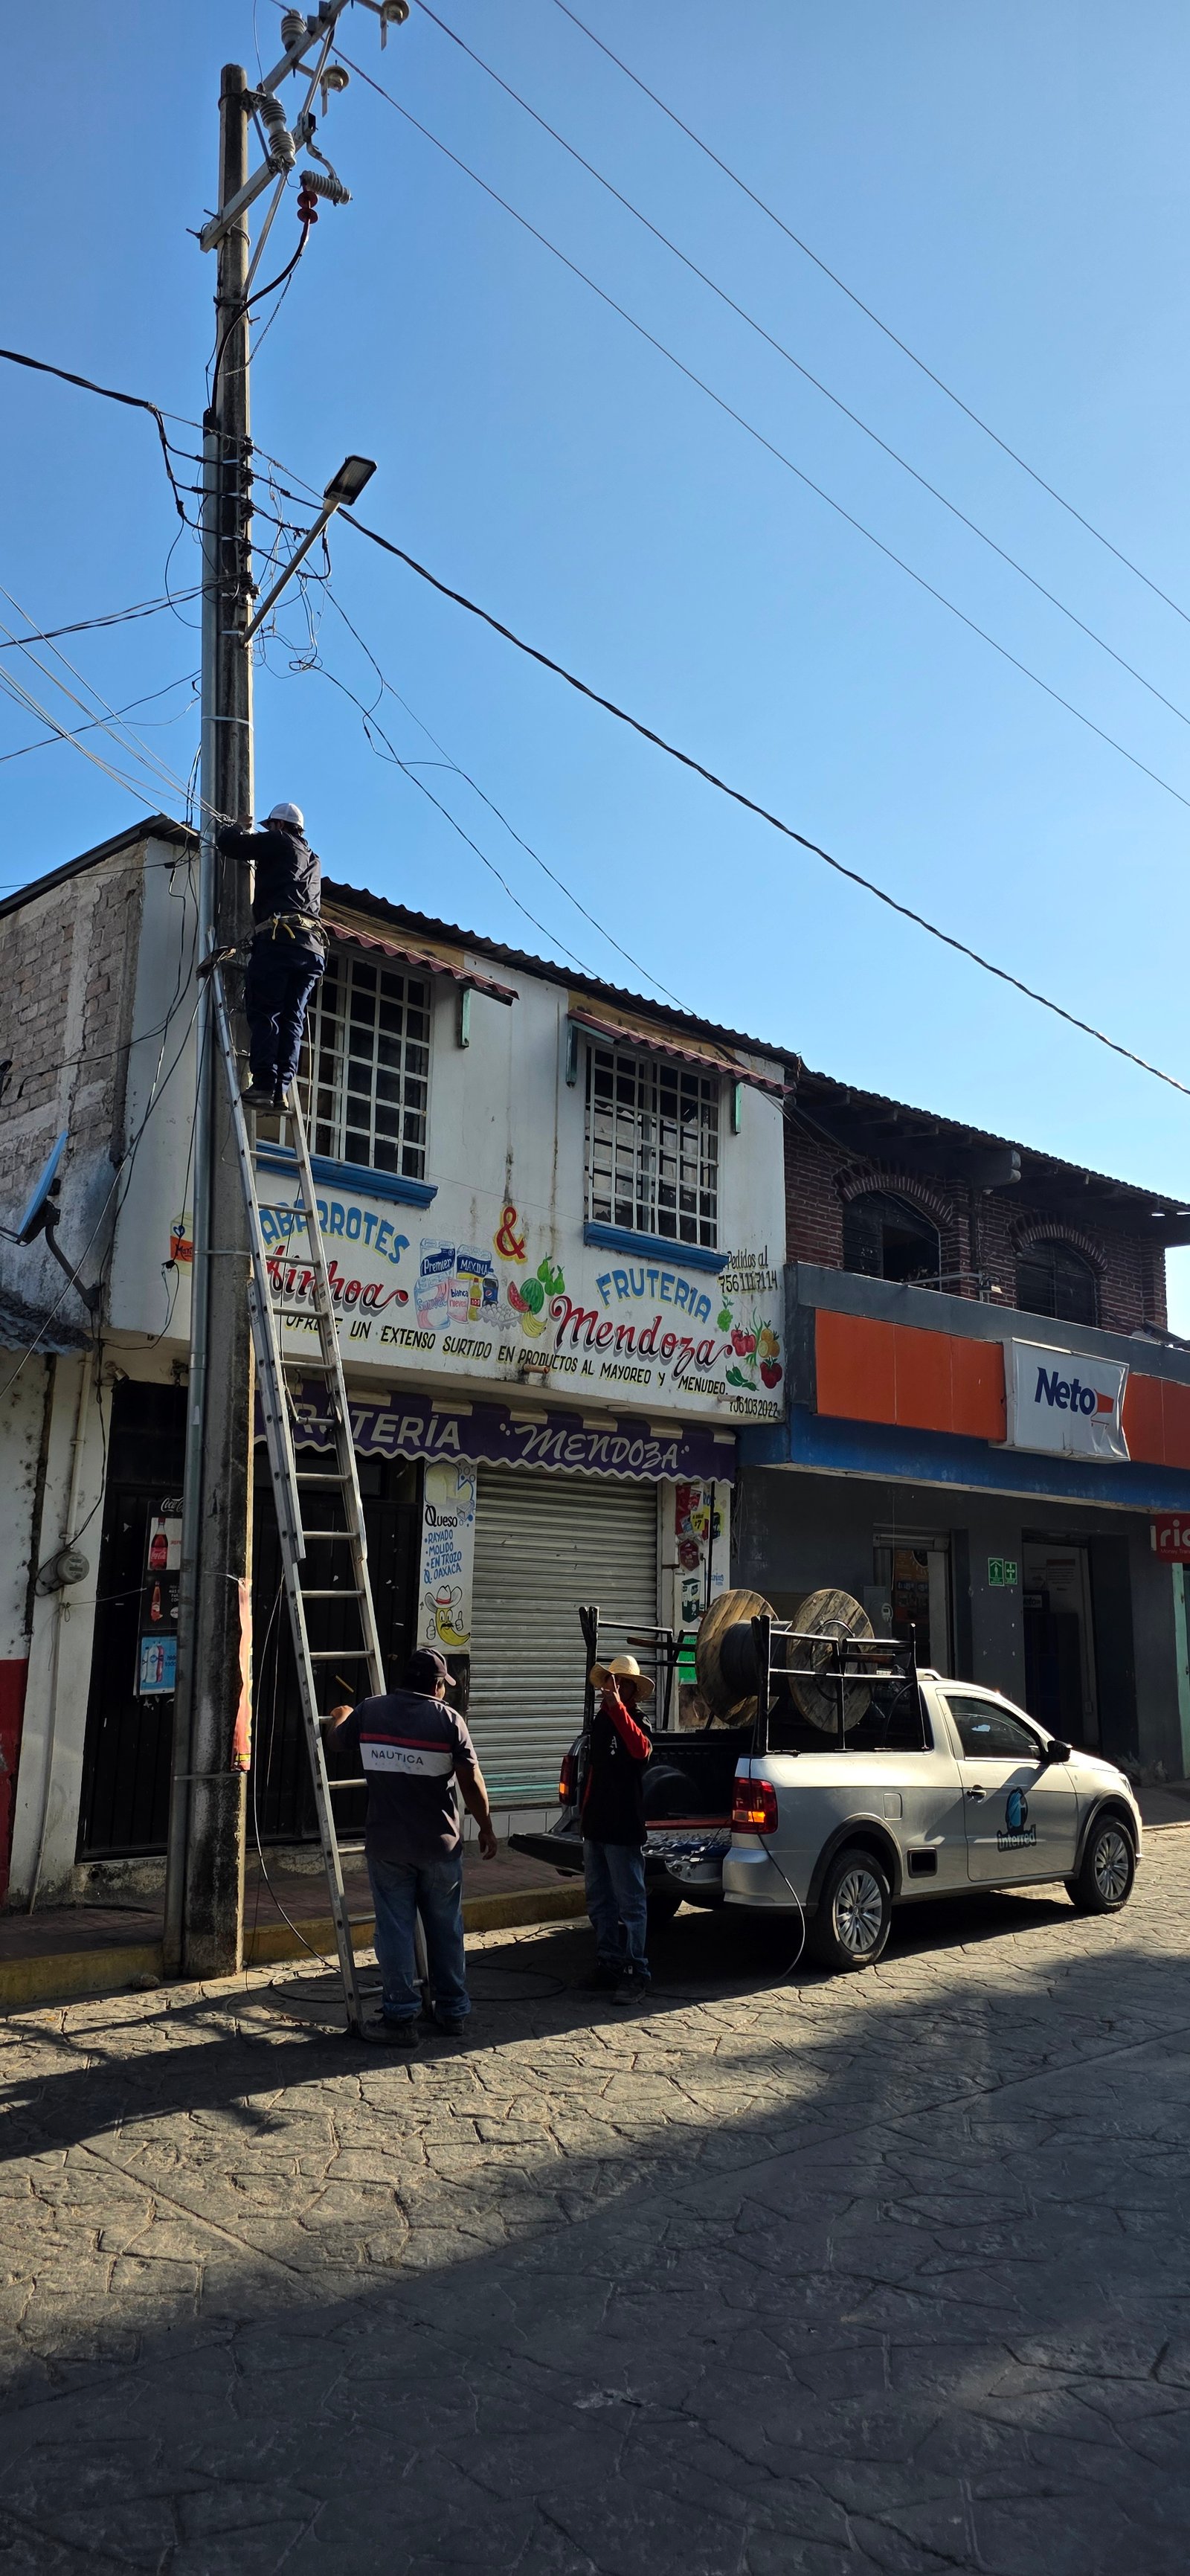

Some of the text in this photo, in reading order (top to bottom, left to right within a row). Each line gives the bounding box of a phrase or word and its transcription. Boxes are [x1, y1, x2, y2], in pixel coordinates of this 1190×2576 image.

[495, 1206, 527, 1262] &
[424, 1258, 452, 1275] Premier
[460, 1259, 488, 1275] MAXIMA
[727, 1245, 769, 1271] Pedidos al
[595, 1267, 713, 1324] FRUTERIA
[551, 1295, 733, 1378] Mendoza
[350, 1320, 372, 1339] UN
[381, 1326, 436, 1349] EXTENSO
[443, 1336, 492, 1358] SURTIDO
[498, 1345, 516, 1364] EN
[518, 1349, 578, 1372] PRODUCTOS
[581, 1359, 594, 1376] AL
[600, 1363, 651, 1384] MAYOREO
[658, 1372, 666, 1387] Y
[1035, 1366, 1096, 1416] Neto
[425, 1505, 458, 1528] Queso
[428, 1529, 454, 1545] RAYADO
[428, 1542, 454, 1556] MOLIDO
[430, 1551, 463, 1568] EN TROZO
[434, 1563, 462, 1579] OAXACA
[371, 1749, 424, 1766] NAUTICA
[998, 1828, 1036, 1849] interred
